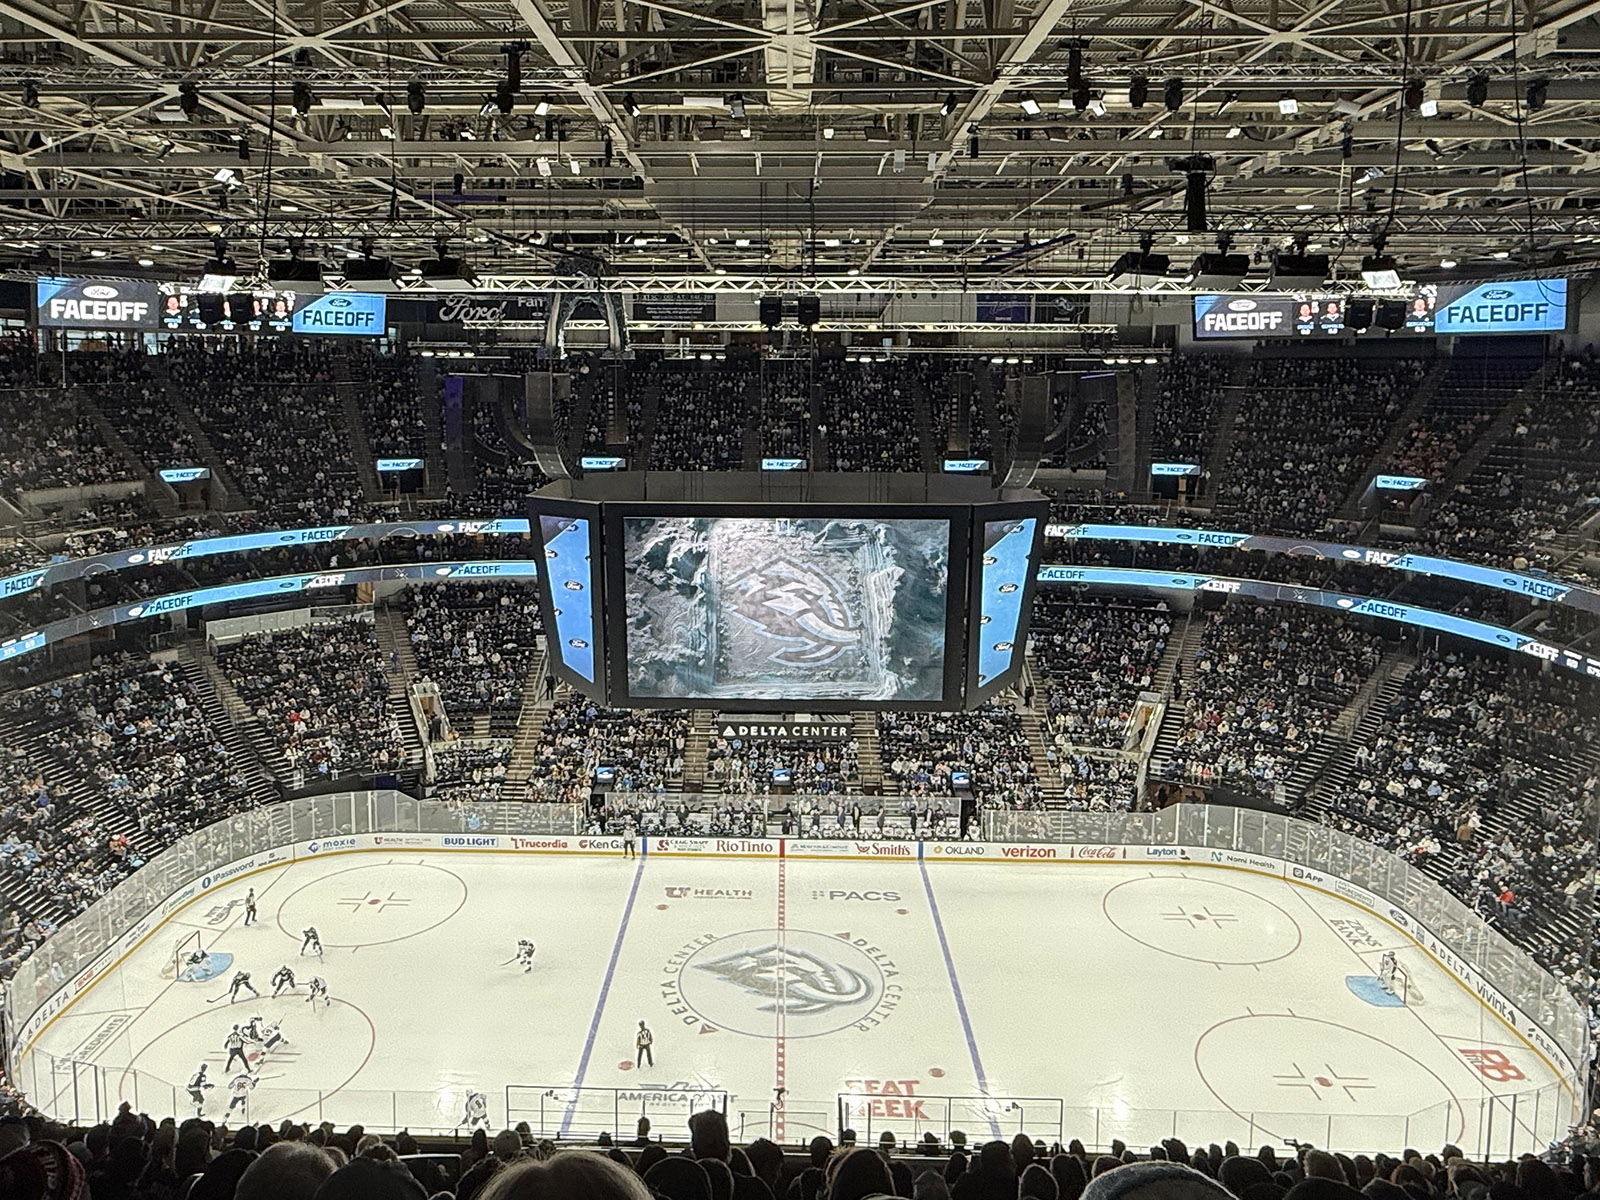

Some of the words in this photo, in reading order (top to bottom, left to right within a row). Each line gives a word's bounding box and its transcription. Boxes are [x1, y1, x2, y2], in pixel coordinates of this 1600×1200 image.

[51, 299, 148, 321] FACEOFF
[440, 294, 506, 321] Ford
[1447, 303, 1550, 323] FACEOFF
[303, 310, 375, 327] FACEOFF
[1204, 311, 1283, 331] FACEOFF
[458, 565, 501, 575] FACEOFF
[1041, 570, 1085, 579] FACEOFF
[150, 595, 193, 612] FACEOFF
[1360, 602, 1408, 619] FACEOFF
[739, 726, 787, 736] DELTA
[792, 726, 848, 737] CENTER
[322, 838, 356, 849] moxie
[444, 838, 465, 846] BUD
[467, 838, 496, 847] LIGHT
[519, 838, 568, 849] Trucordia
[588, 839, 609, 849] Ken
[872, 843, 911, 855] Smith's
[945, 846, 985, 855] OKLAND
[1002, 845, 1057, 858] verizon
[1146, 847, 1177, 856] Layton
[1226, 855, 1248, 864] Nomi
[1250, 858, 1275, 870] Health
[829, 890, 902, 901] PACS
[663, 933, 719, 974] CENTER
[853, 938, 899, 978] DELTA
[1439, 951, 1472, 984] DELTA
[34, 991, 70, 1029] DELTA
[660, 980, 700, 1026] DELTA
[853, 984, 904, 1032] CENTER
[618, 1092, 689, 1102] AMERICA
